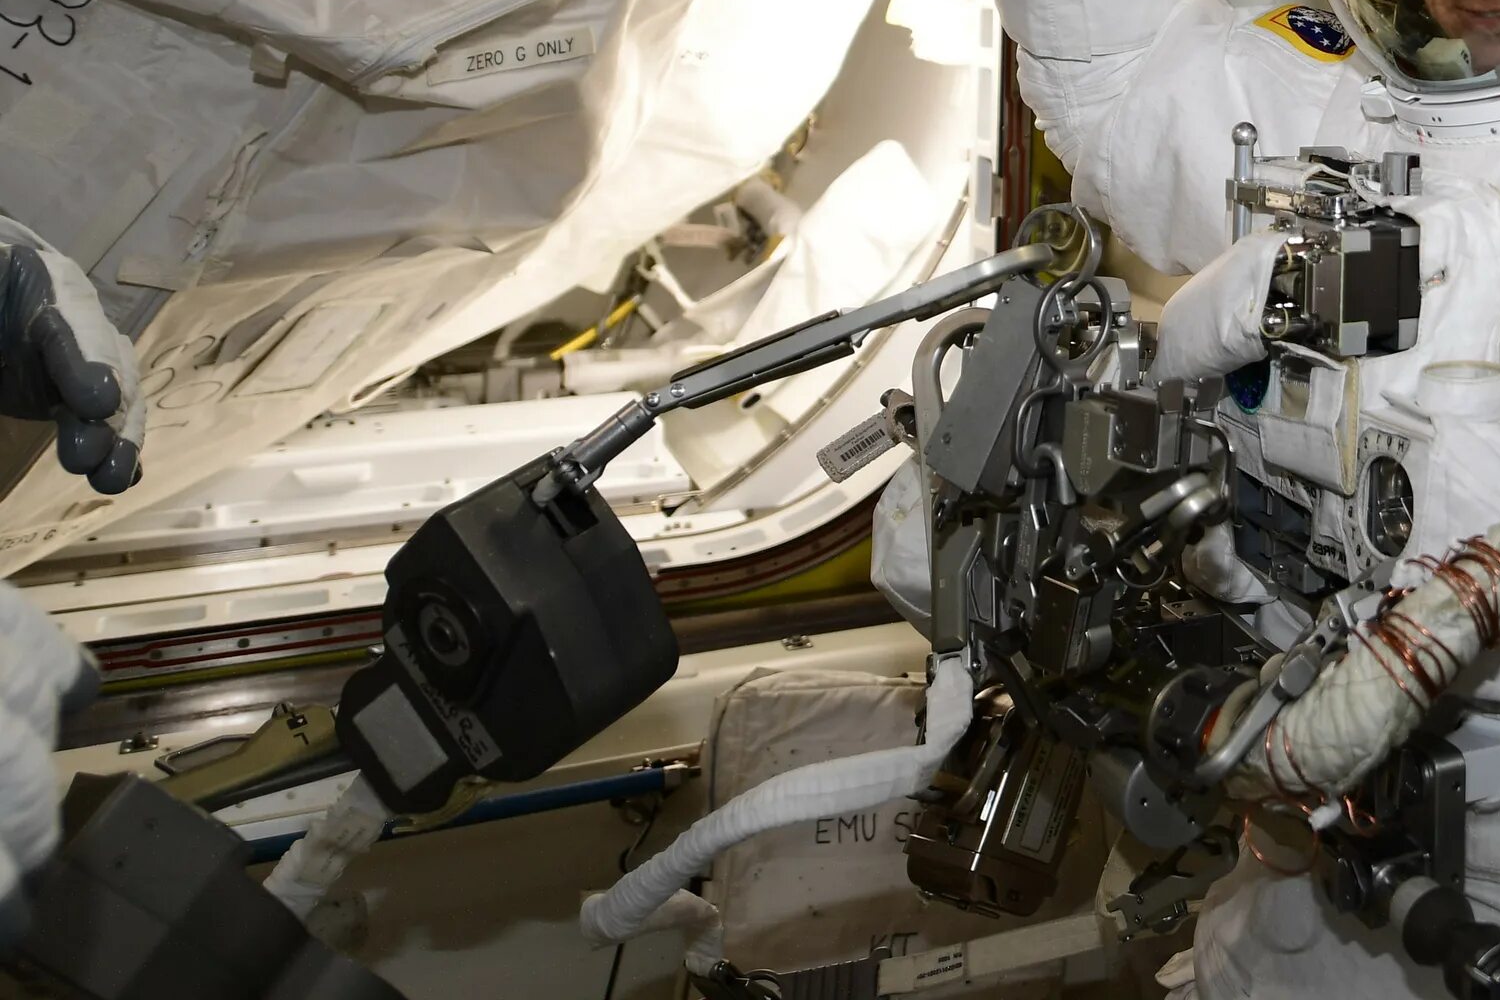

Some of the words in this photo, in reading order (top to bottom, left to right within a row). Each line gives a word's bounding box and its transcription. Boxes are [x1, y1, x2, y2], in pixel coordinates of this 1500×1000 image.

[466, 50, 504, 72] ZERO
[516, 46, 526, 61] G
[536, 38, 574, 57] ONLY
[816, 813, 876, 843] EMU
